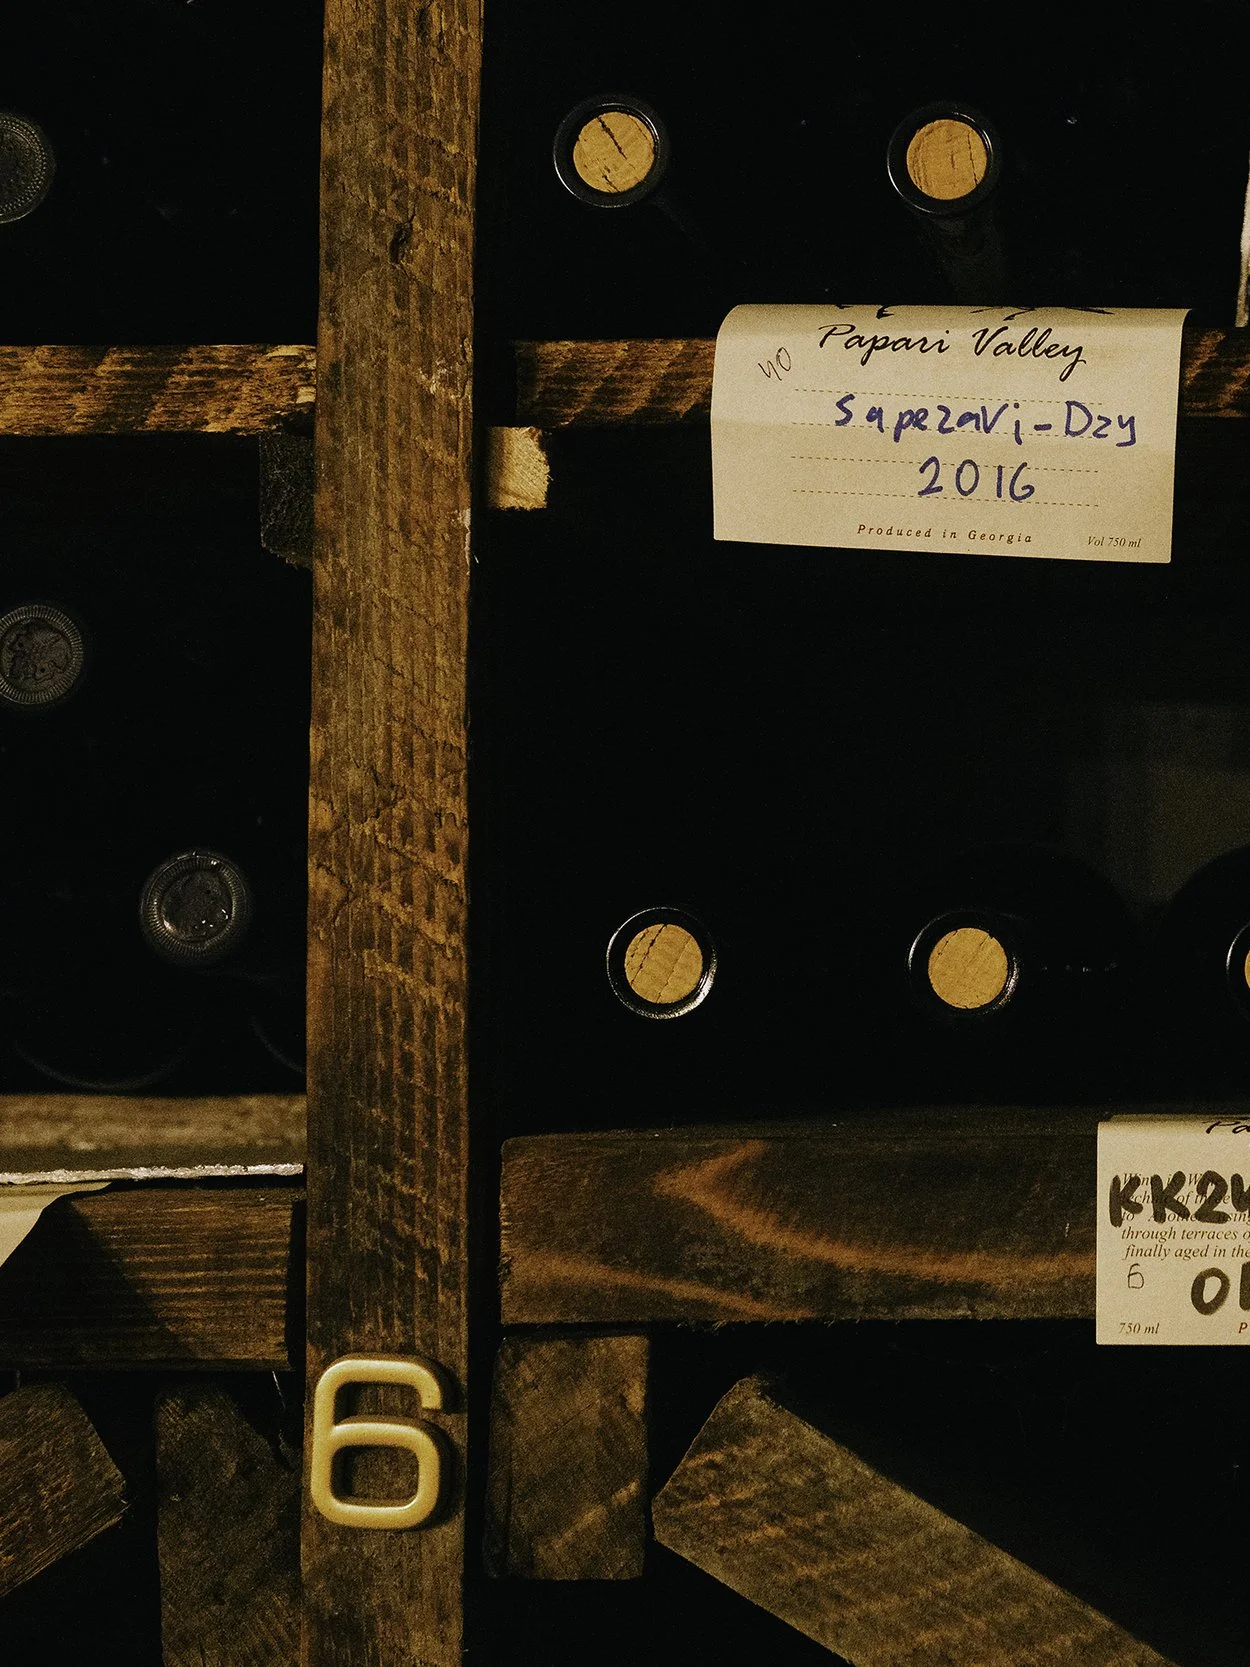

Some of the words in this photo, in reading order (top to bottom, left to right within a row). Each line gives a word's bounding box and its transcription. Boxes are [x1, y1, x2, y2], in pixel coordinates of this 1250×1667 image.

[818, 323, 951, 367] Papari
[972, 326, 1088, 382] Valley
[917, 456, 1035, 502] 2016
[857, 524, 933, 539] Produced
[943, 529, 958, 540] in
[968, 530, 1033, 545] Georgia
[1087, 536, 1104, 547] Vol
[1107, 537, 1127, 548] 750
[1128, 539, 1142, 549] ml
[1176, 1191, 1193, 1205] of
[1121, 1226, 1176, 1243] through
[1181, 1229, 1238, 1240] terraces
[1123, 1244, 1170, 1263] finally
[1175, 1244, 1209, 1260] aged
[1213, 1246, 1226, 1257] in
[1119, 1323, 1140, 1334] 750
[1143, 1323, 1159, 1334] ml
[310, 1359, 441, 1530] 6
